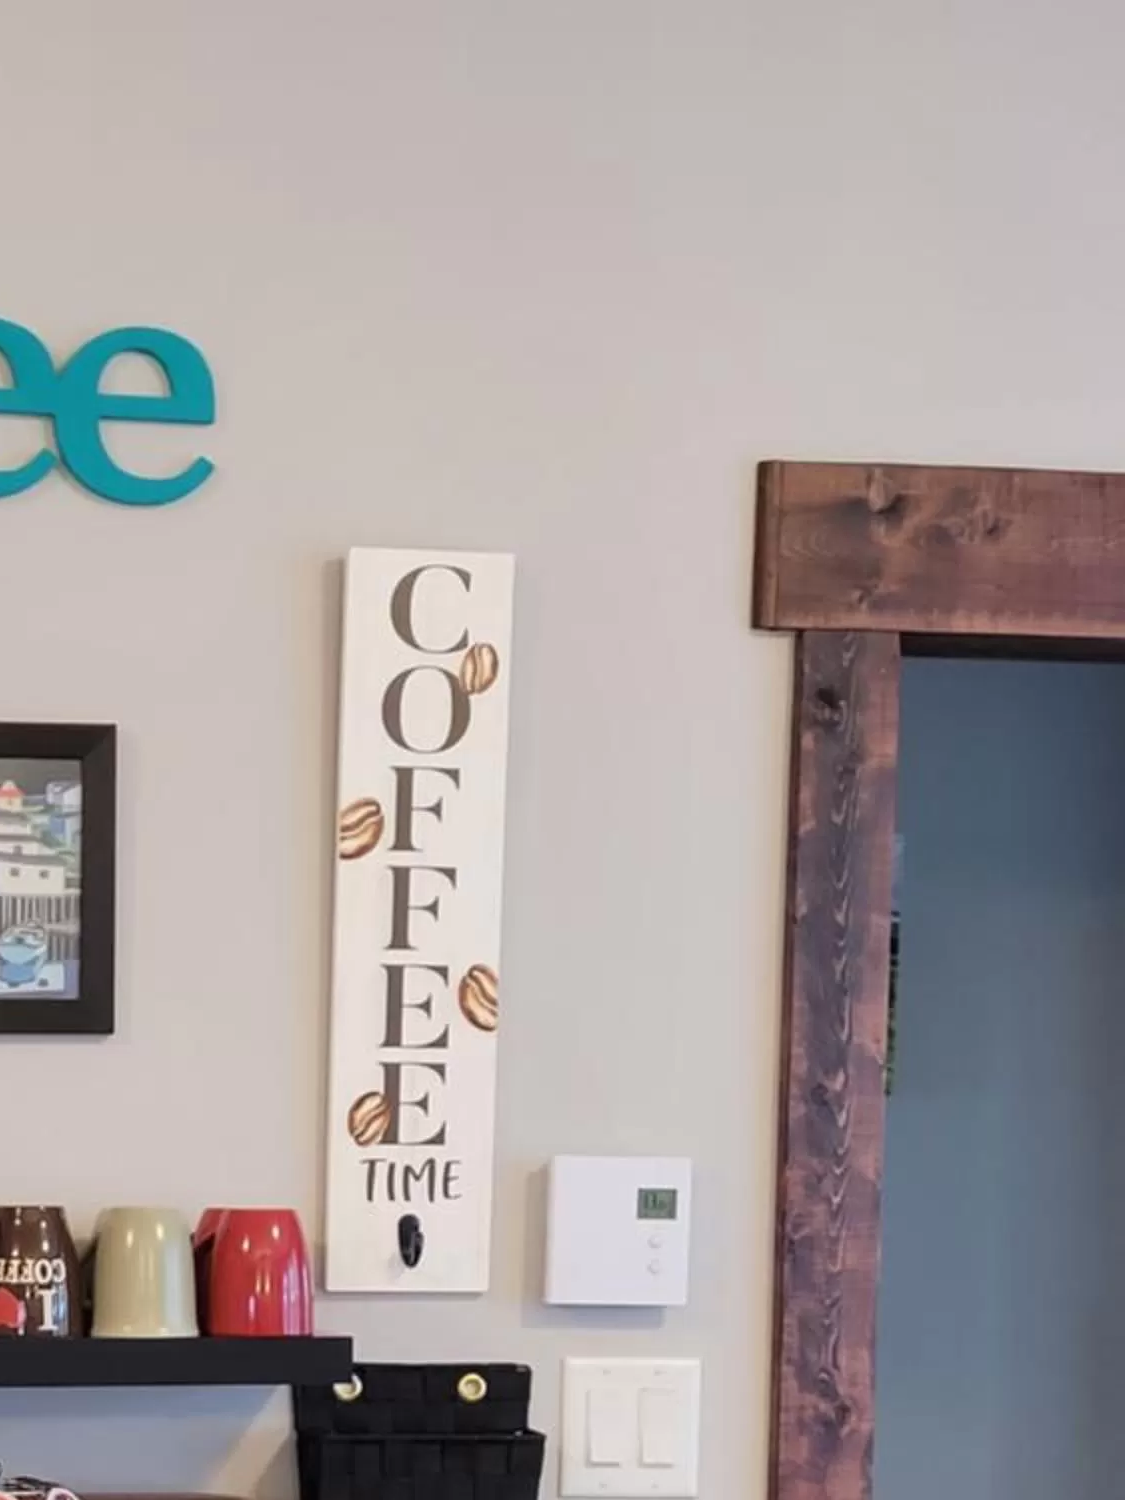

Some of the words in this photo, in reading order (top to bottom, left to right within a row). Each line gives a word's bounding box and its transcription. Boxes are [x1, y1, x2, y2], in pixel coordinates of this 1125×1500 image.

[376, 563, 472, 1147] COFFEE
[359, 1157, 463, 1204] TIME
[36, 1286, 60, 1331] I
